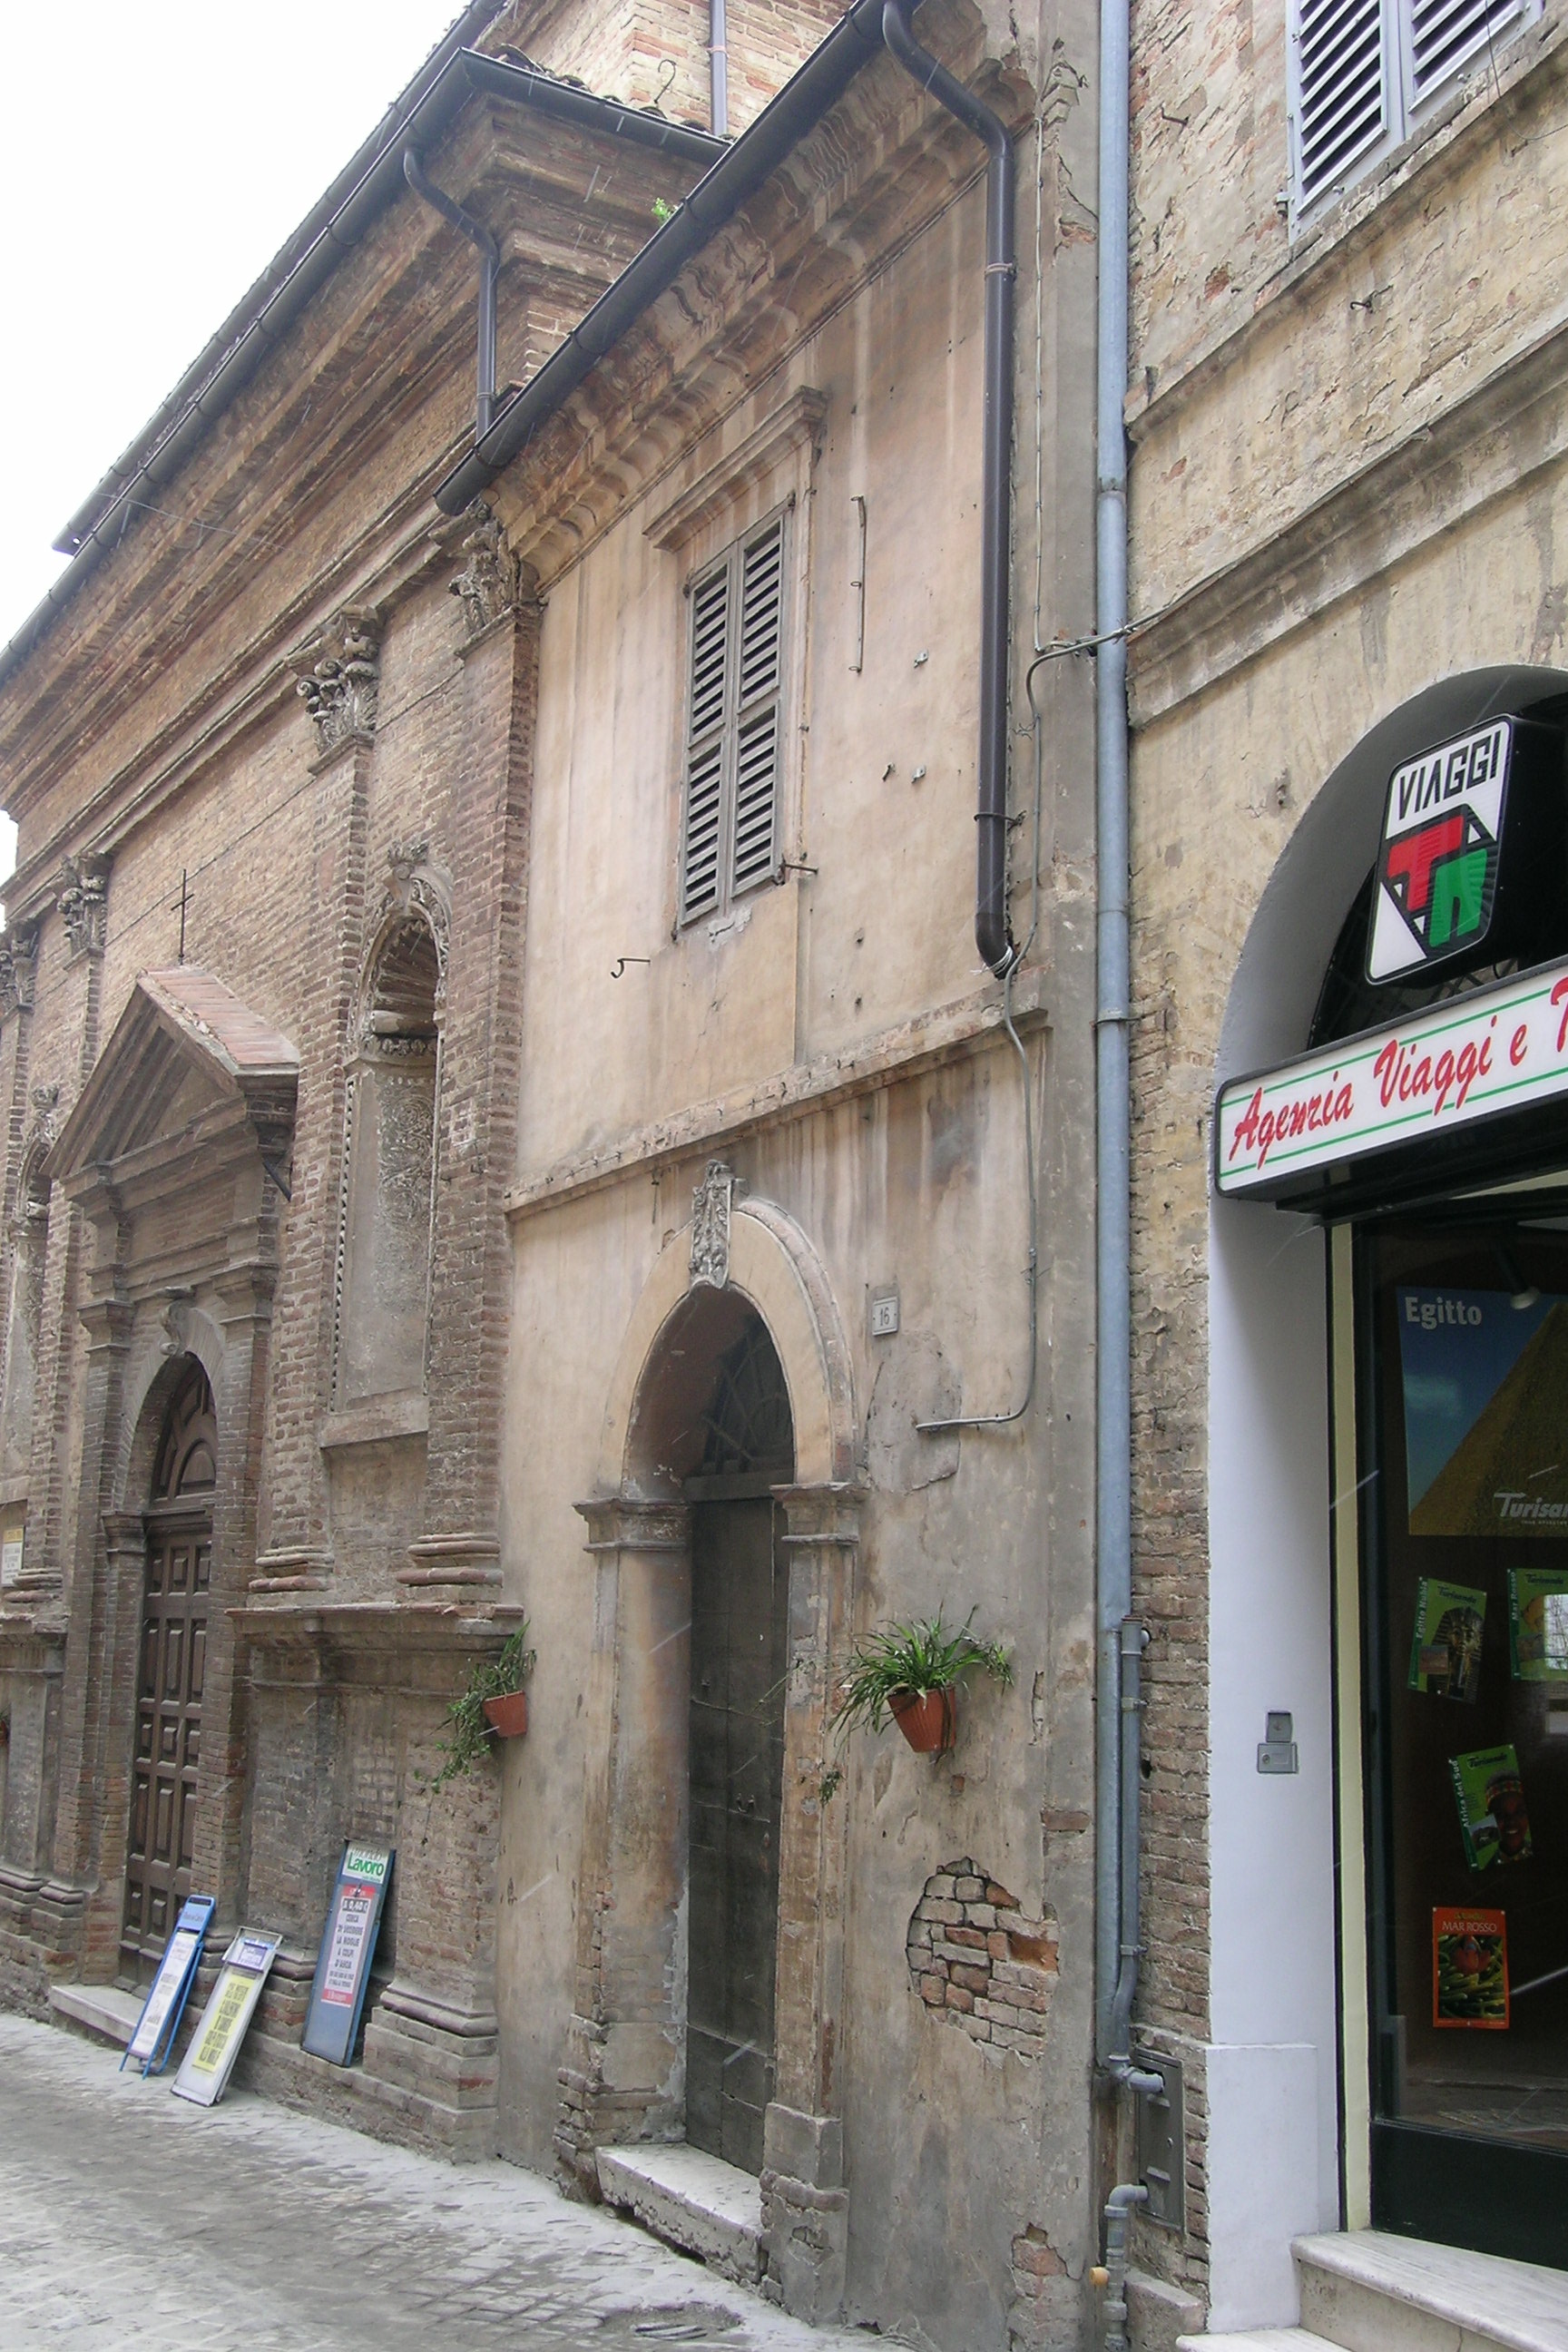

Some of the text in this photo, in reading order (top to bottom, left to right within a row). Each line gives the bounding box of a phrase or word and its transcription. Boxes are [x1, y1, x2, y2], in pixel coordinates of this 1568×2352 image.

[1398, 730, 1502, 820] VIAGGI
[1229, 1015, 1528, 1170] Agenzia Viaggi e
[879, 1307, 890, 1327] 16
[1404, 1296, 1483, 1330] Egitto
[348, 1852, 385, 1877] Lavoro
[1442, 1921, 1497, 1933] MAR ROSSO
